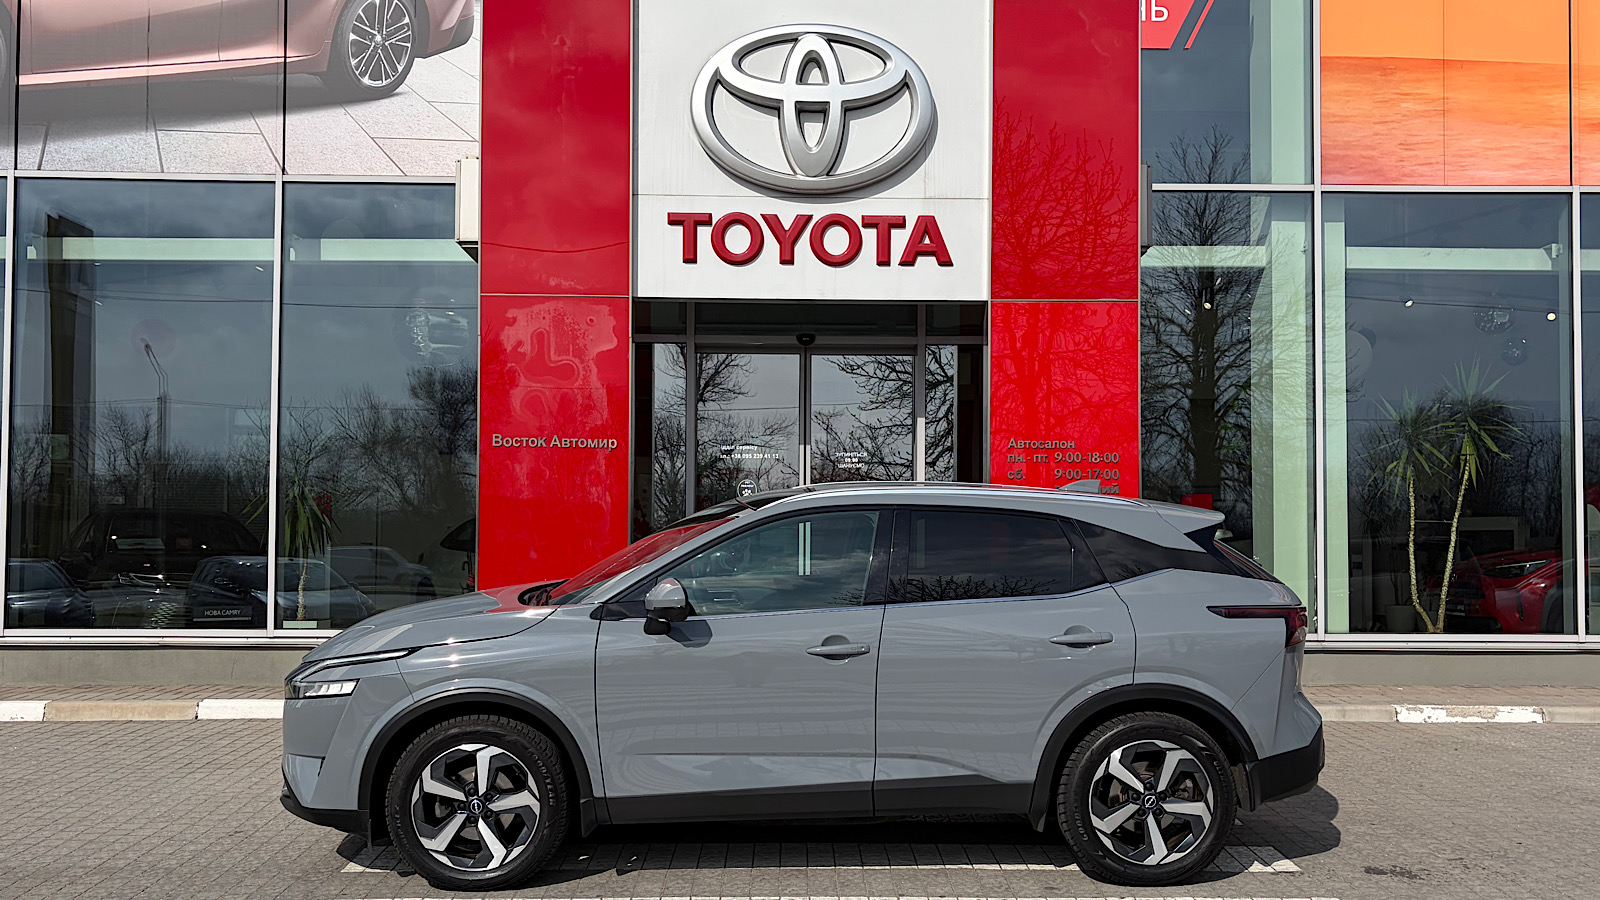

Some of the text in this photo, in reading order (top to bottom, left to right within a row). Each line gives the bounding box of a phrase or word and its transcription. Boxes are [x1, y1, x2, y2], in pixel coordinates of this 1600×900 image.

[667, 211, 954, 267] TOYOTA
[492, 433, 618, 451] Восток Автомир
[1007, 438, 1076, 450] Автосалон
[1007, 453, 1026, 463] пн.
[1033, 453, 1049, 463] пт.
[1054, 452, 1120, 464] 9:00-18:00
[1007, 468, 1120, 480] сб. 9:00-17:00
